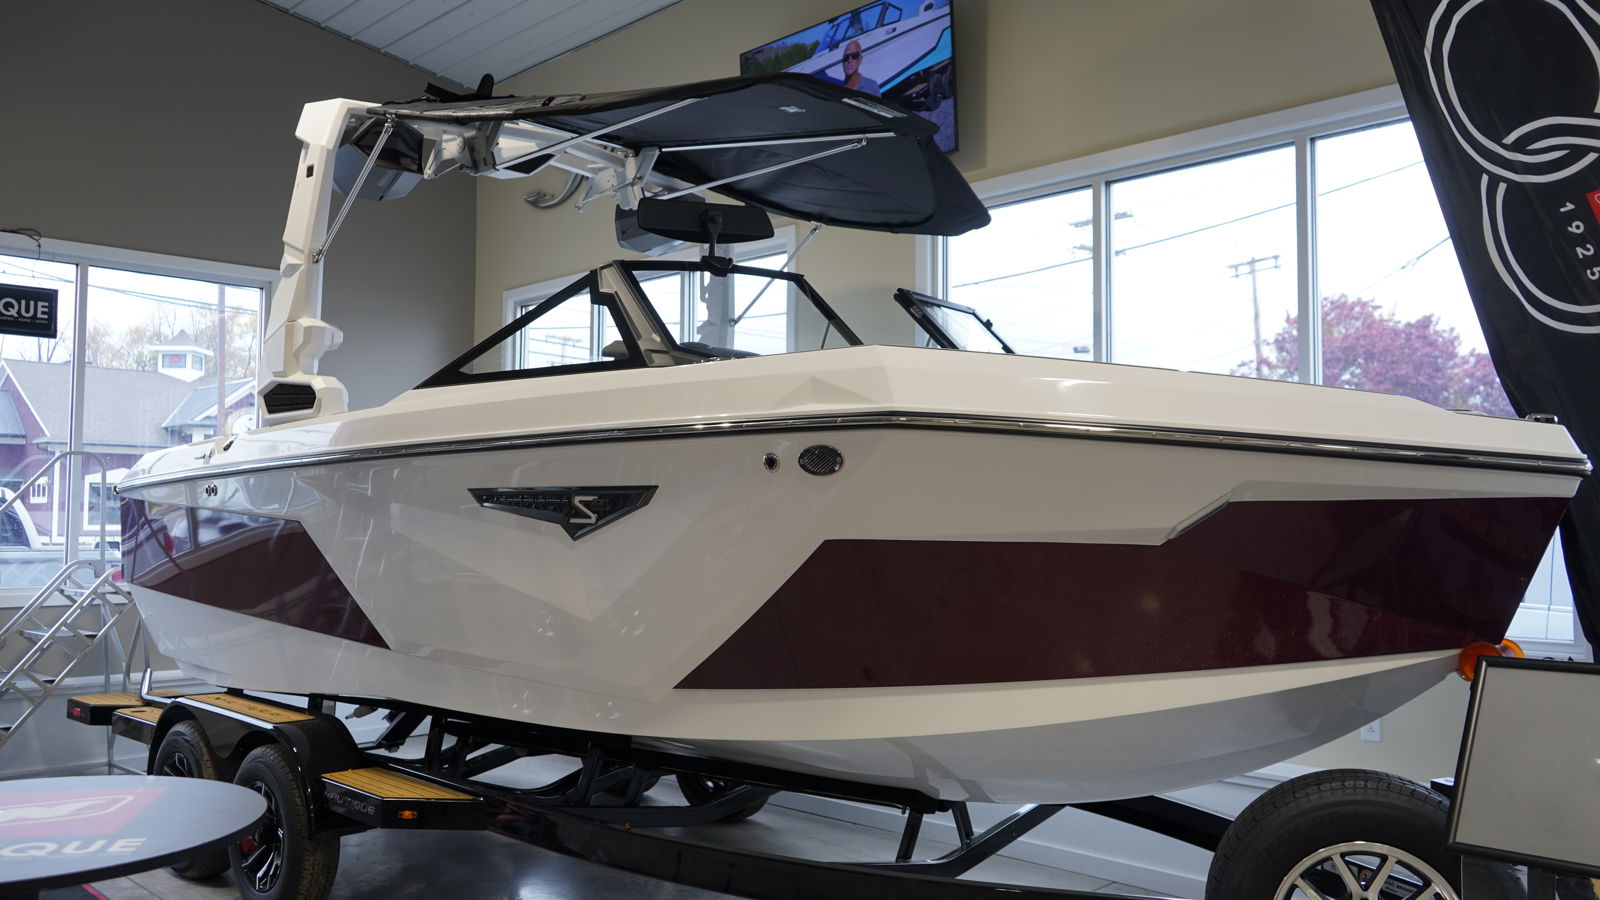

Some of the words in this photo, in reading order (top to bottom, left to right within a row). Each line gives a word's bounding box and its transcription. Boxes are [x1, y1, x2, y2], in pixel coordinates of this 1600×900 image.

[1560, 202, 1600, 280] 1925
[0, 297, 49, 319] QUE
[324, 790, 376, 815] NAUTIQUE
[0, 838, 147, 857] QUE
